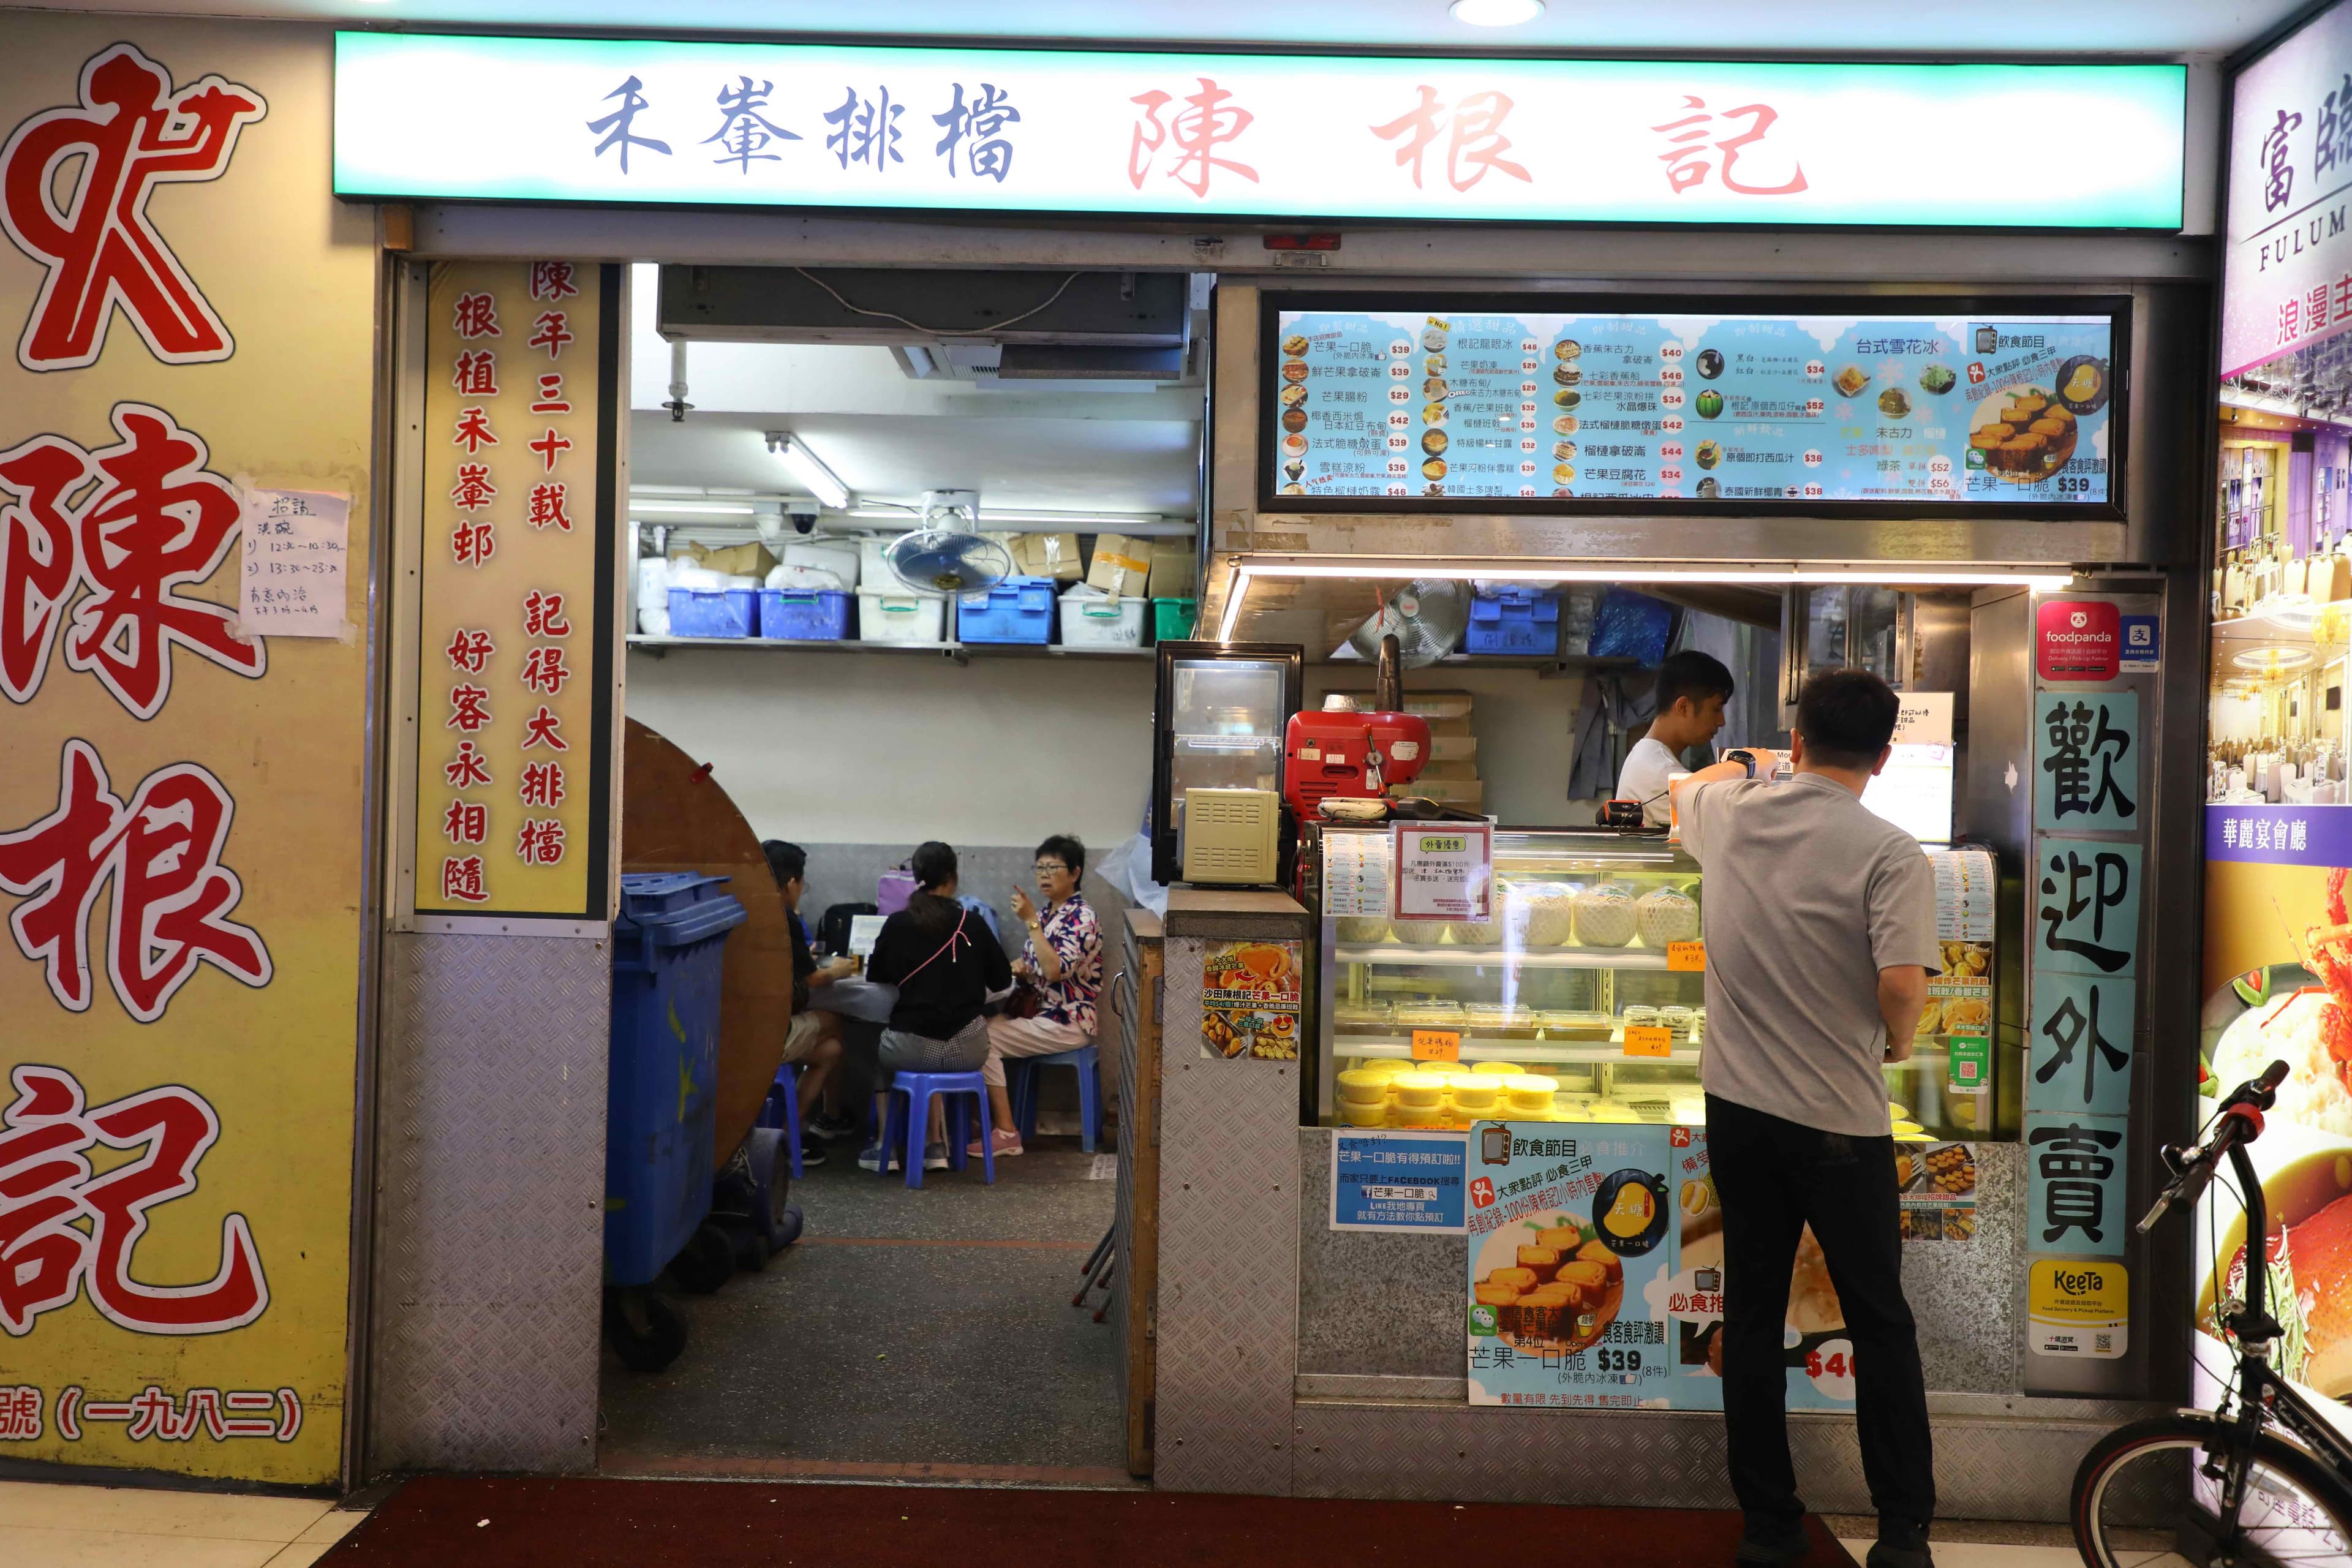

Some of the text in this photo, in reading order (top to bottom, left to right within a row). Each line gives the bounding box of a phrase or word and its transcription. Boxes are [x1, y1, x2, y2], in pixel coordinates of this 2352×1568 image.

[1128, 77, 1809, 198] 陳根記
[2259, 205, 2346, 272] FULUM
[1314, 341, 1372, 352] 芒果一口脆
[1457, 338, 1513, 350] 根記龍眼冰
[1856, 339, 1939, 355] 台式雪花冰
[1999, 335, 2045, 348] 飲食節目
[1582, 344, 1634, 354] 香蕉朱古力
[1460, 361, 1498, 370] 芒果奶凍
[1623, 355, 1653, 364] 拿破崙
[1311, 366, 1382, 378] 鮮芒果拿破崙
[1588, 371, 1640, 381] 七彩香蕉船
[1322, 391, 1368, 402] 芒果腸粉
[1582, 391, 1654, 401] 七彩芒果涼粉拼
[1453, 403, 1513, 413] 香蕉/芒果班戟
[1616, 402, 1657, 412] 水晶爆珠
[1311, 411, 1409, 424] 椰香西米焗 $42
[1324, 420, 1387, 431] 日本紅豆布甸
[1876, 427, 1912, 439] 朱古力
[1312, 437, 1382, 450] 法式脆糖燉蛋
[1584, 445, 1646, 457] 榴槤拿破崙
[1845, 445, 1893, 456] 士多啤梨
[1726, 453, 1795, 463] 原個即打西瓜汁
[1319, 462, 1366, 473] 雪糕涼粉
[1450, 463, 1515, 473] 芒果河粉伴雪糕
[1877, 460, 1901, 471] 綠茶
[1931, 463, 1949, 472] $52
[1584, 468, 1646, 481] 芒果豆腐花
[1447, 484, 1503, 494] 韓國士多啤梨
[1931, 479, 1950, 488] $56
[1965, 476, 2049, 492] 芒果一口脆
[2057, 477, 2090, 492] $39
[1725, 486, 1782, 497] 泰國新鮮椰青
[2046, 631, 2112, 644] foodpanda
[517, 589, 570, 865] 記得大排檔
[443, 628, 494, 902] 好客永相隨
[2223, 818, 2307, 851] 華麗宴會廳
[2029, 700, 2136, 1243] 歡迎外賣
[1204, 989, 1299, 1002] 沙田陳根記芒果一口脆
[1512, 1138, 1577, 1158] 飲食節目
[1338, 1151, 1461, 1165] 芒果一口脆有得預訂啦!!
[1496, 1155, 1593, 1200] 大眾點評 必食三甲
[1373, 1187, 1425, 1199] 芒果一口脆
[1357, 1210, 1444, 1223] 就有方法教你點預訂
[2054, 1270, 2103, 1295] KeeTa
[1603, 1320, 1665, 1346] 食客食評激讚
[1514, 1336, 1545, 1348] 第4位
[1469, 1346, 1667, 1378] 芒果一口脆 $39 (8件)
[1500, 1393, 1643, 1407] 數量有限 先到先得 售完即止
